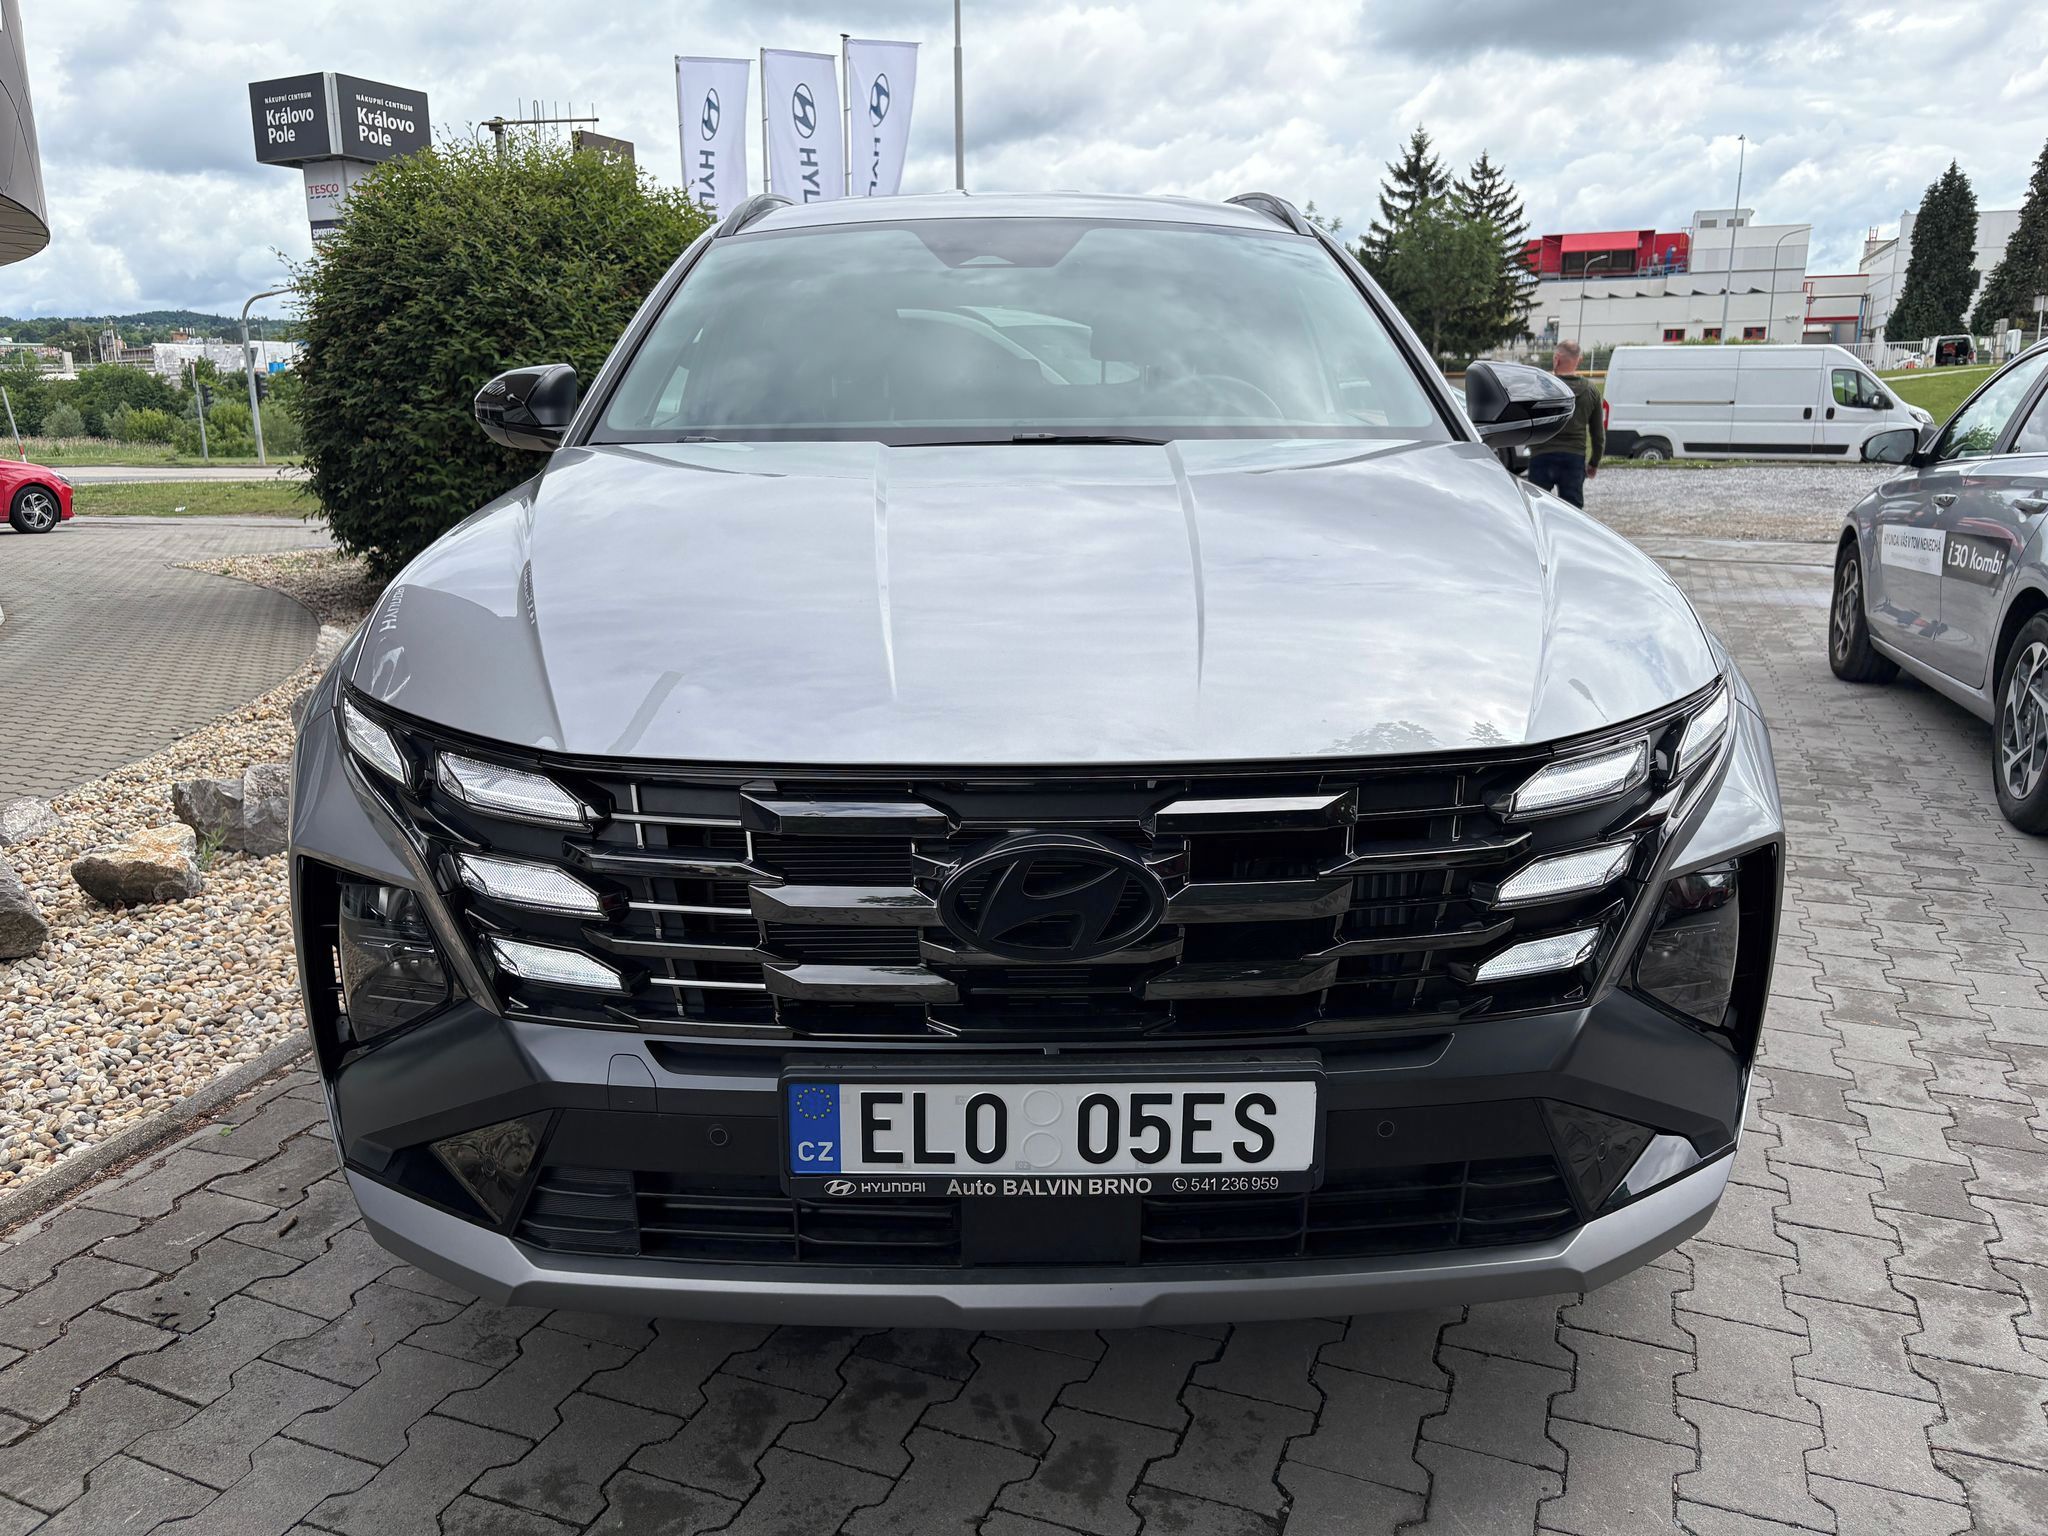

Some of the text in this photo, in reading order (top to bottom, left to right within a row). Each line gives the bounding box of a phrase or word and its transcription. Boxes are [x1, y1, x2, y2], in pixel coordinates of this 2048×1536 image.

[264, 91, 312, 104] NÁKUPNÍ CENTRUM
[355, 94, 414, 112] NÁKUPNÍ CENTRUM
[266, 106, 314, 126] Královo
[357, 106, 415, 133] Královo
[267, 125, 296, 144] Pole
[358, 124, 392, 147] Pole
[308, 183, 339, 195] TESCO
[1947, 541, 1969, 568] i30
[1969, 546, 2005, 575] kombi
[798, 1141, 834, 1162] CZ
[861, 1182, 926, 1193] HYUNDAI
[946, 1177, 1152, 1196] Auto BALVIN BRNO
[1190, 1176, 1279, 1192] 541 236 959
